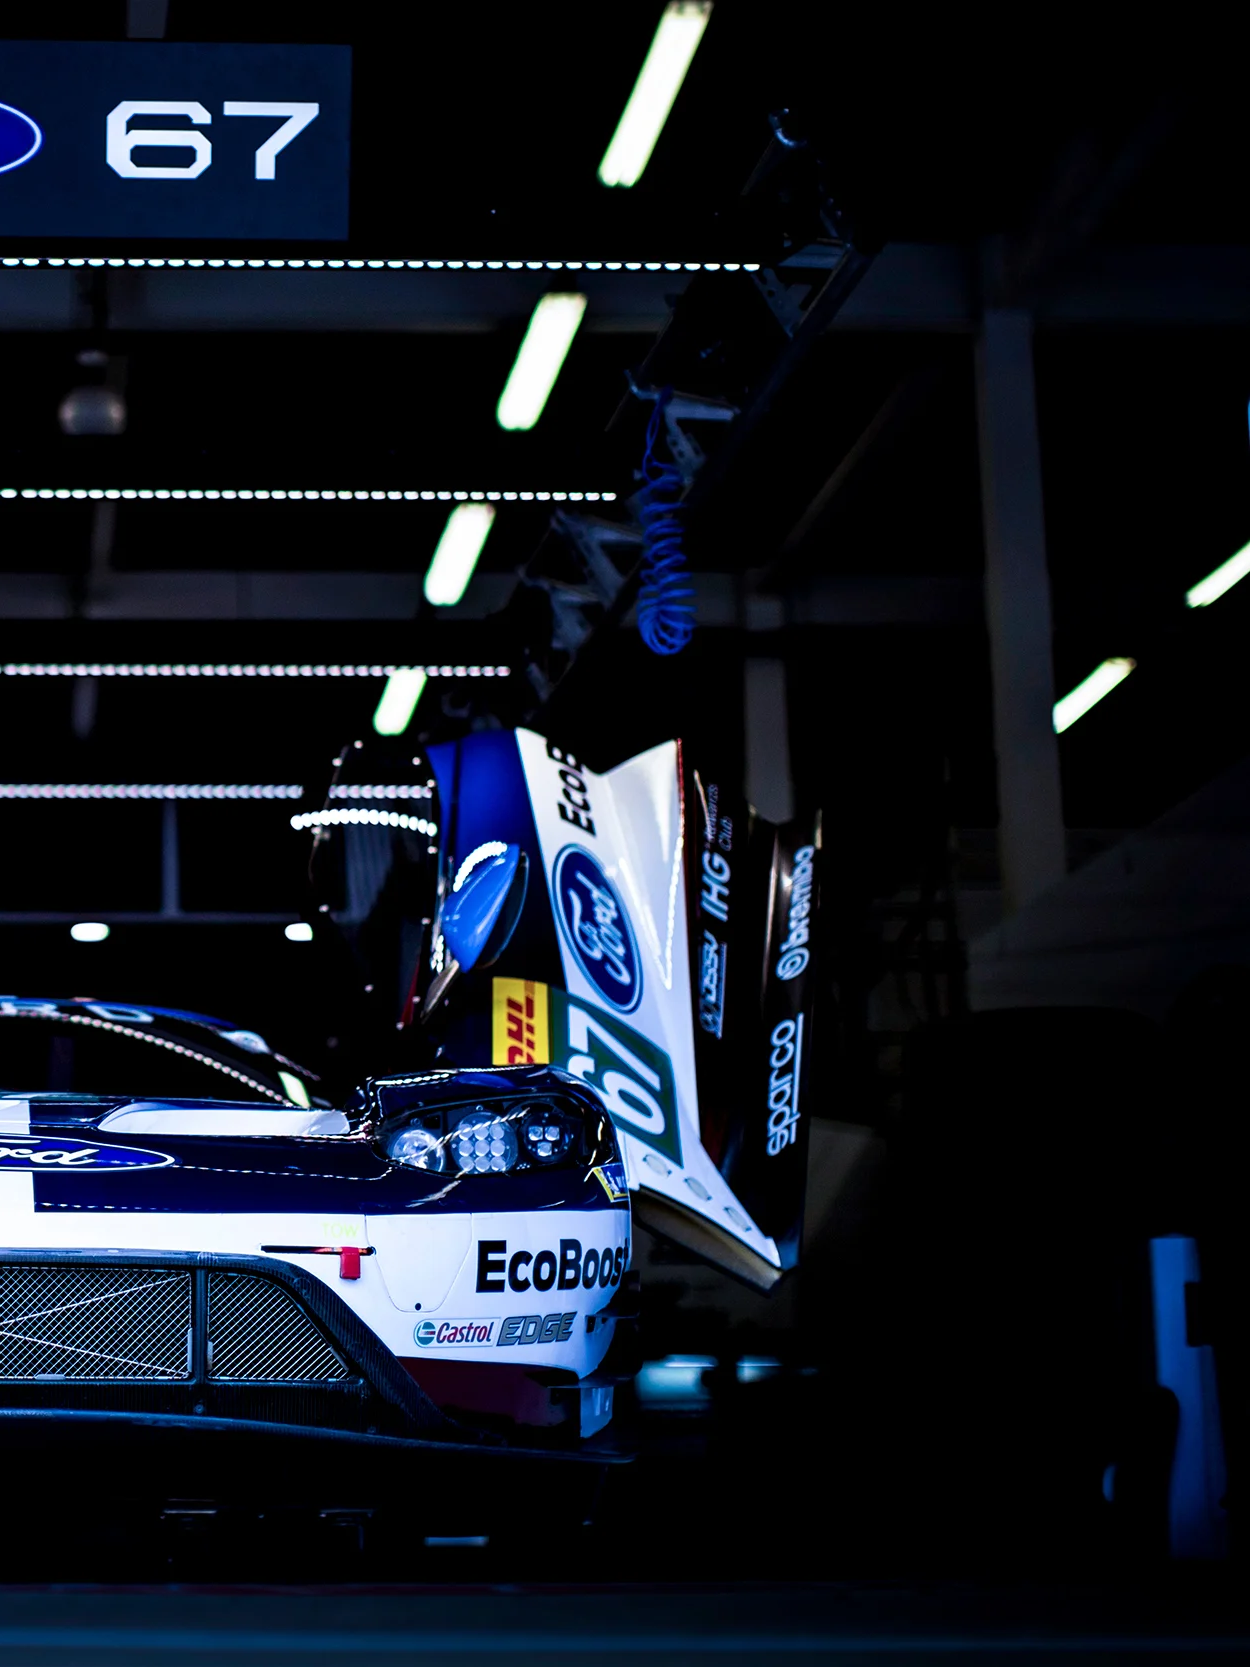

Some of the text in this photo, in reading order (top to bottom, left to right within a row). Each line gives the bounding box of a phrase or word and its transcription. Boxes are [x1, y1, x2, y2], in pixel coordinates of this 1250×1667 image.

[105, 100, 320, 180] 67
[717, 815, 734, 852] Club
[701, 850, 733, 923] IHG
[779, 844, 815, 953] brembo
[567, 870, 632, 986] Ford
[507, 996, 535, 1065] DHL
[567, 1002, 666, 1136] 67
[766, 1013, 802, 1157] sparco
[321, 1222, 360, 1239] TOW
[475, 1237, 629, 1293] EcoBoost
[436, 1311, 578, 1347] Castrol EDGE
